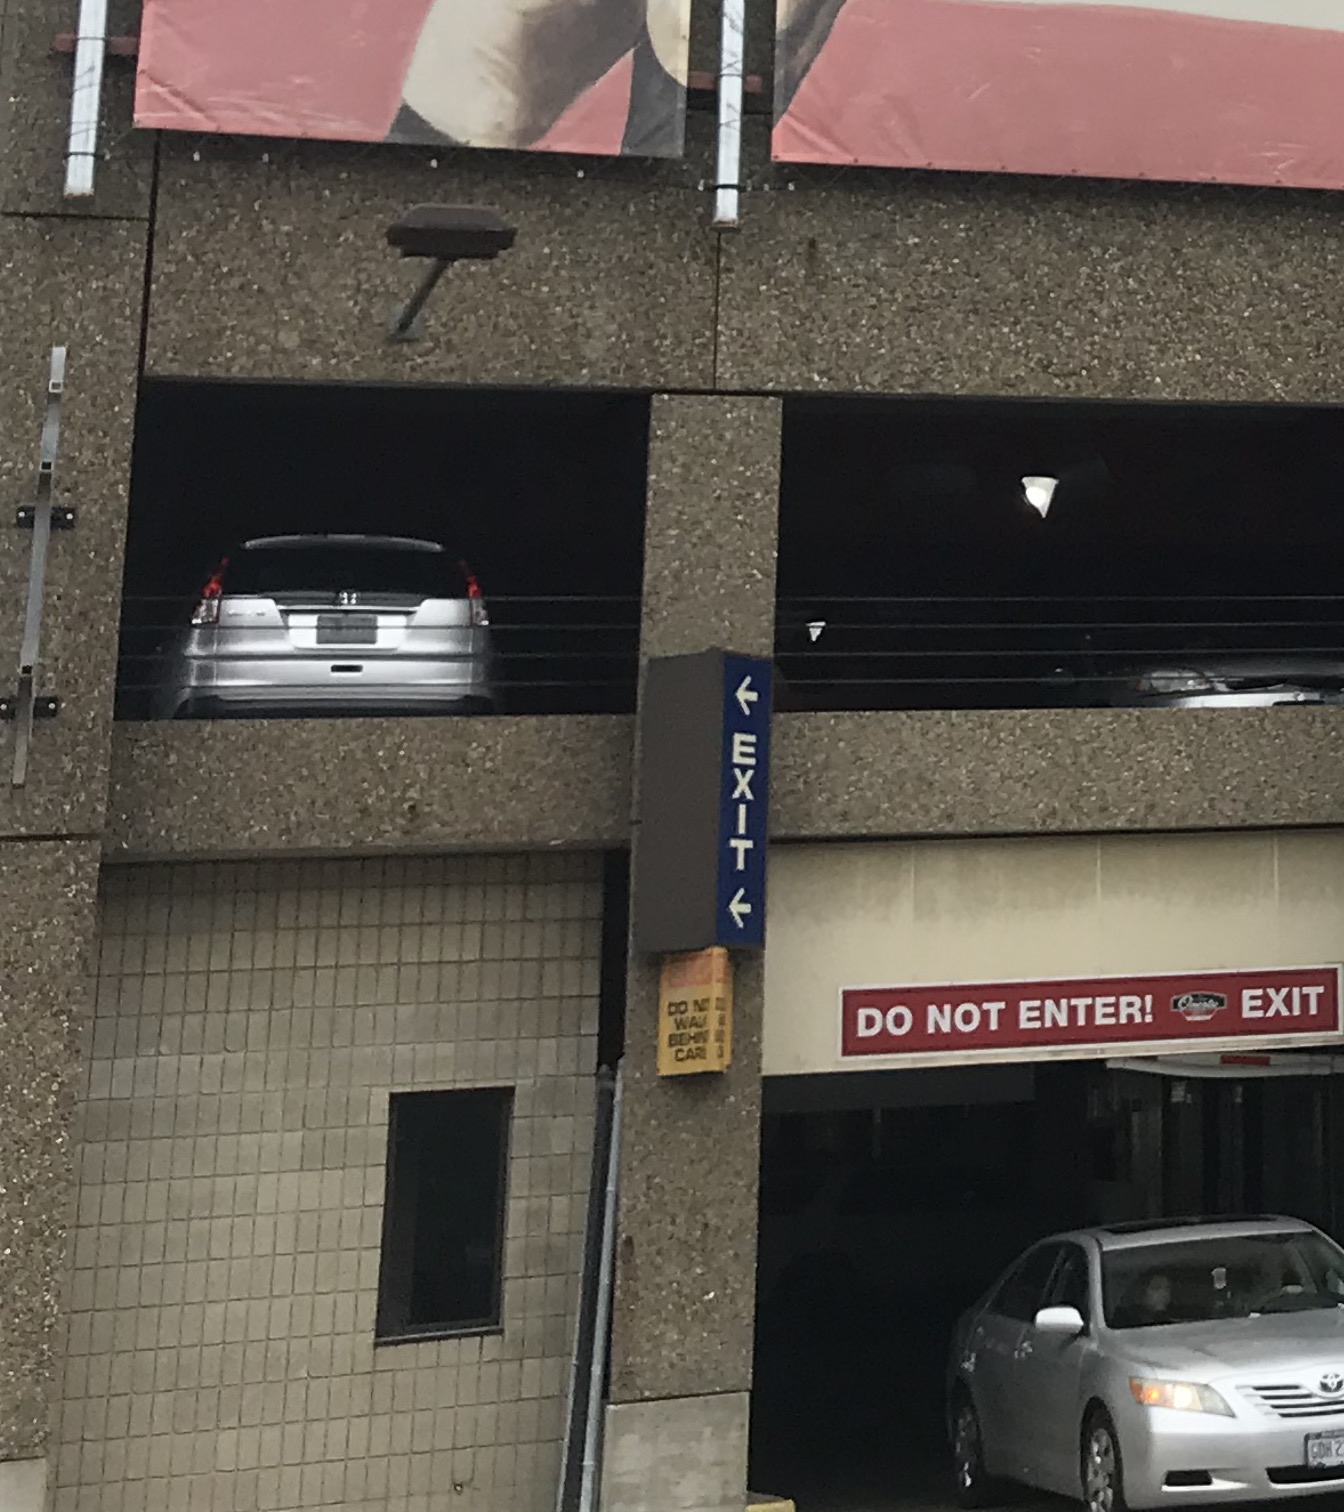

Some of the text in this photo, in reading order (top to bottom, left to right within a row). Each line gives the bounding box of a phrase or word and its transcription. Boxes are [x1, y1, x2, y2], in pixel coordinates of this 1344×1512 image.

[729, 731, 757, 871] EXIT
[857, 1005, 913, 1037] DO
[926, 1001, 1006, 1034] NOT
[1018, 994, 1153, 1029] ENTER!
[1241, 985, 1324, 1018] EXIT
